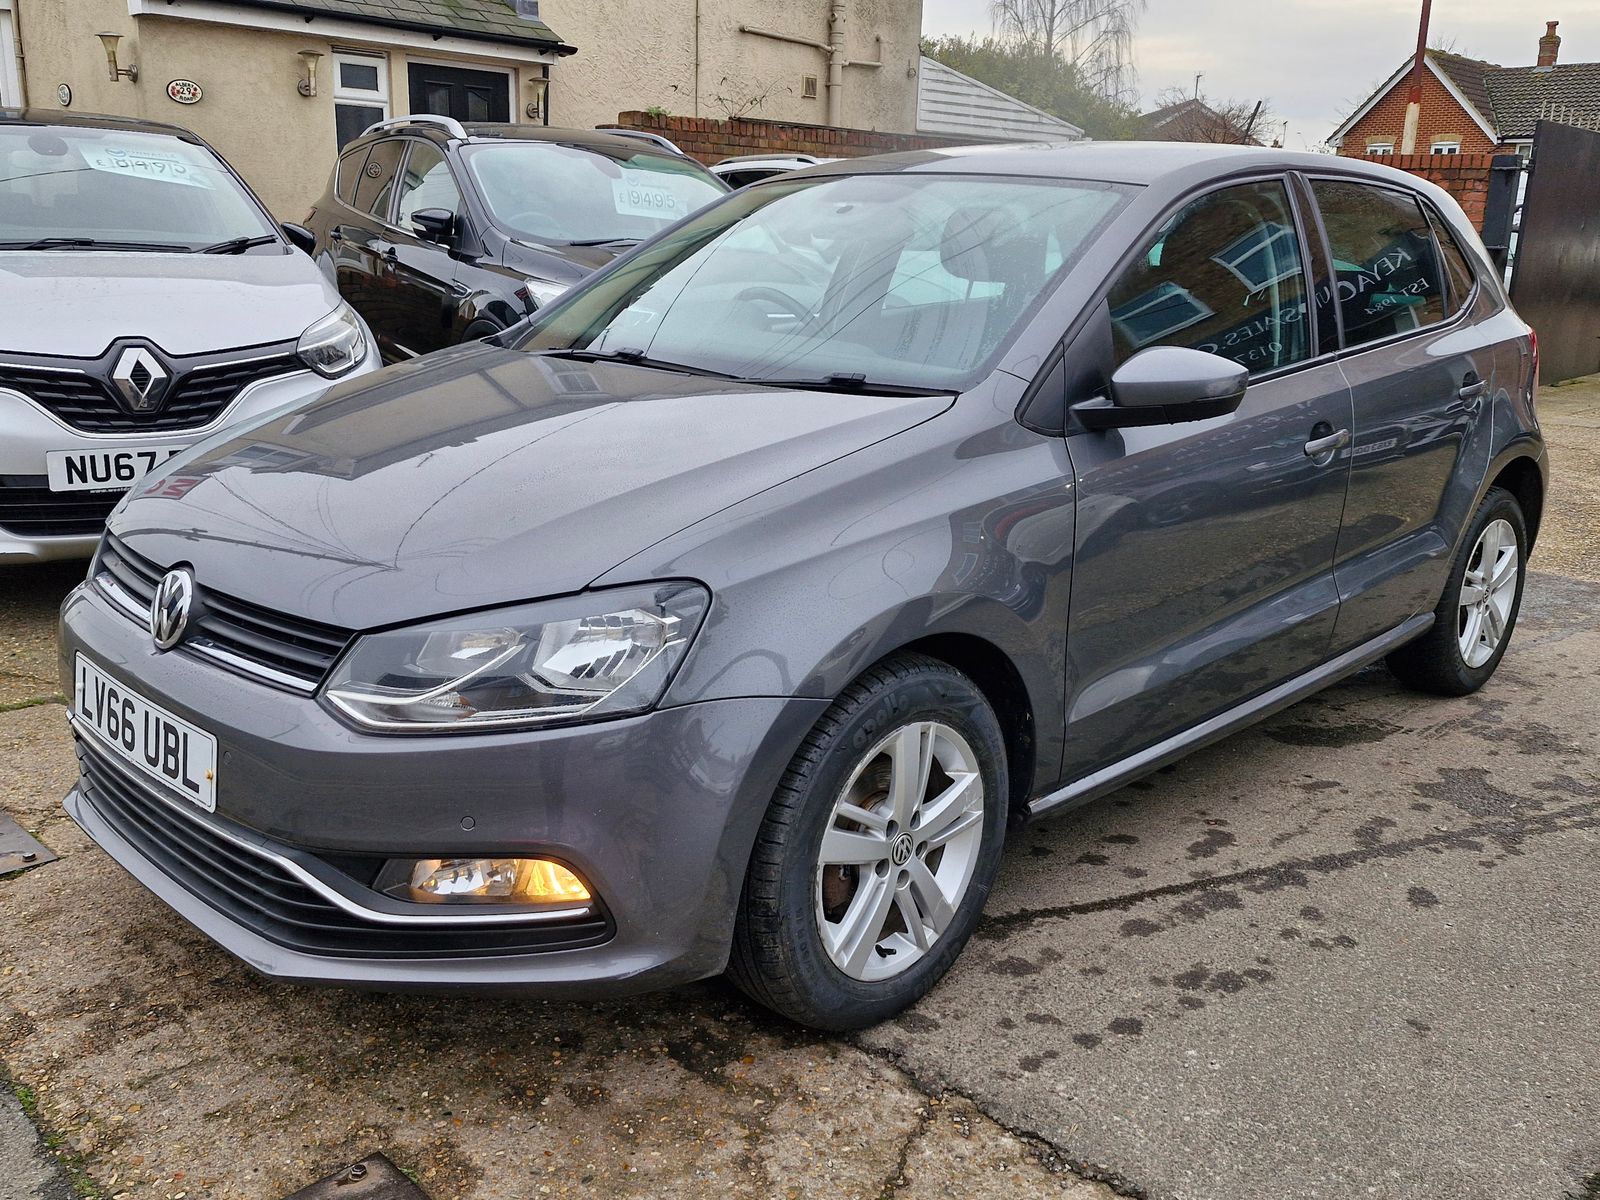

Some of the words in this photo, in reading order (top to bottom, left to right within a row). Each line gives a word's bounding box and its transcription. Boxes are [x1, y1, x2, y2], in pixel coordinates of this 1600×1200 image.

[179, 87, 192, 95] 29
[65, 451, 157, 485] NU67
[81, 666, 136, 752] LV66
[144, 709, 200, 795] UBL
